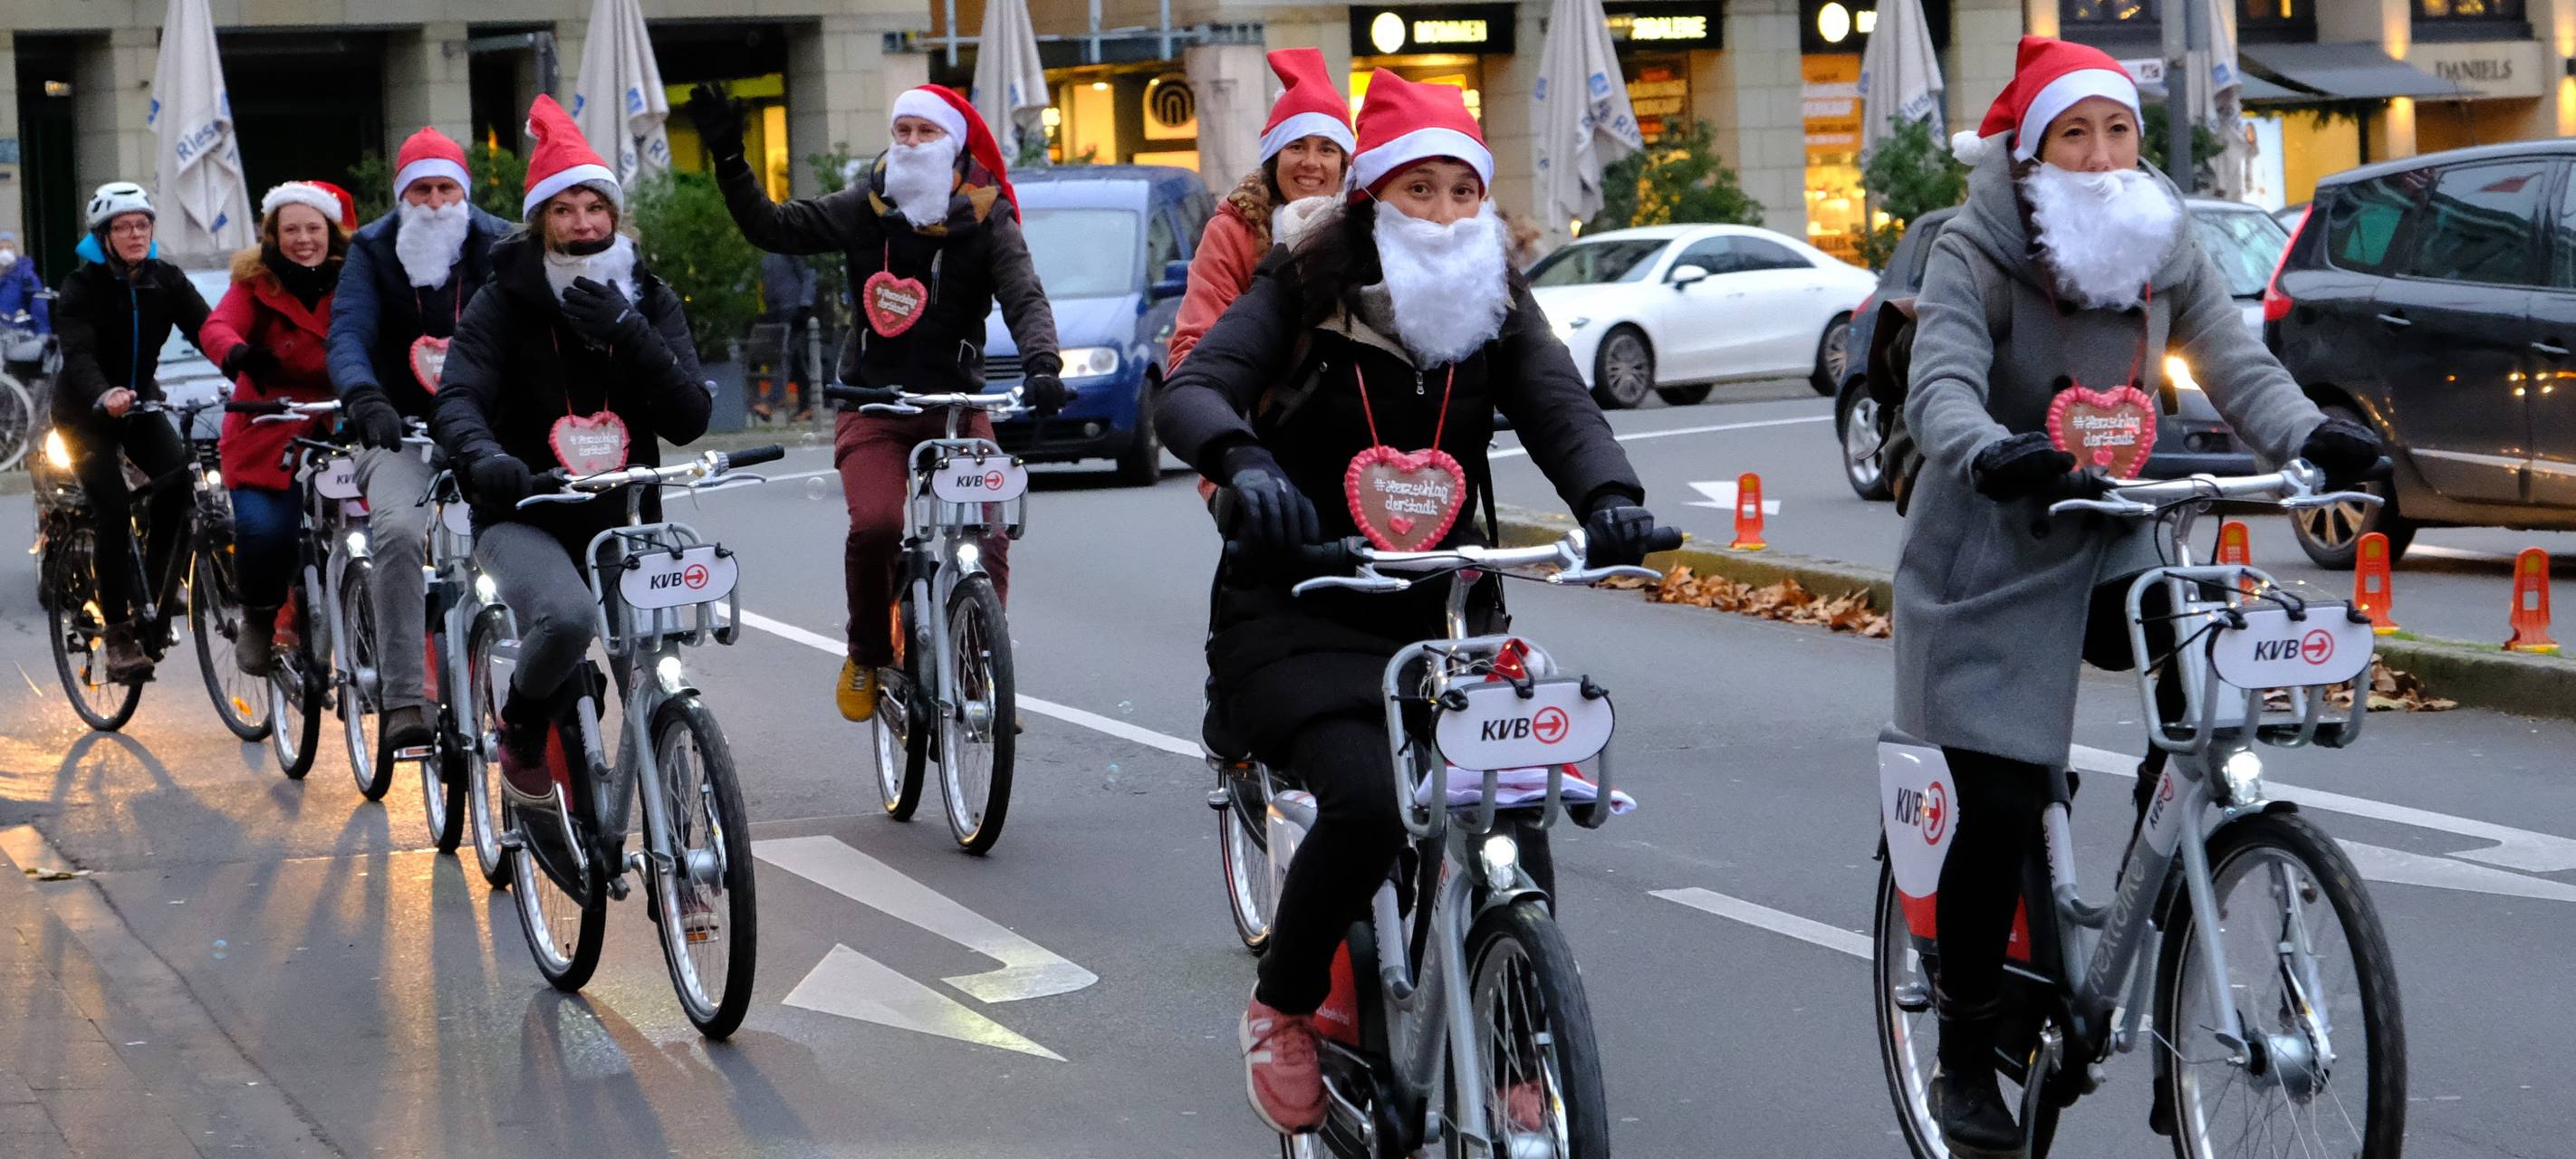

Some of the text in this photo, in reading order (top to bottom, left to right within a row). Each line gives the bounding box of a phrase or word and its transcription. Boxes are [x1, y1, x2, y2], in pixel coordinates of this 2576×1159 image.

[2436, 60, 2514, 80] DANIELS
[956, 475, 984, 487] KVB
[650, 571, 683, 589] KVB
[2254, 639, 2300, 662] KVB
[1480, 717, 1531, 742] KVB
[1895, 787, 1927, 827] KVB
